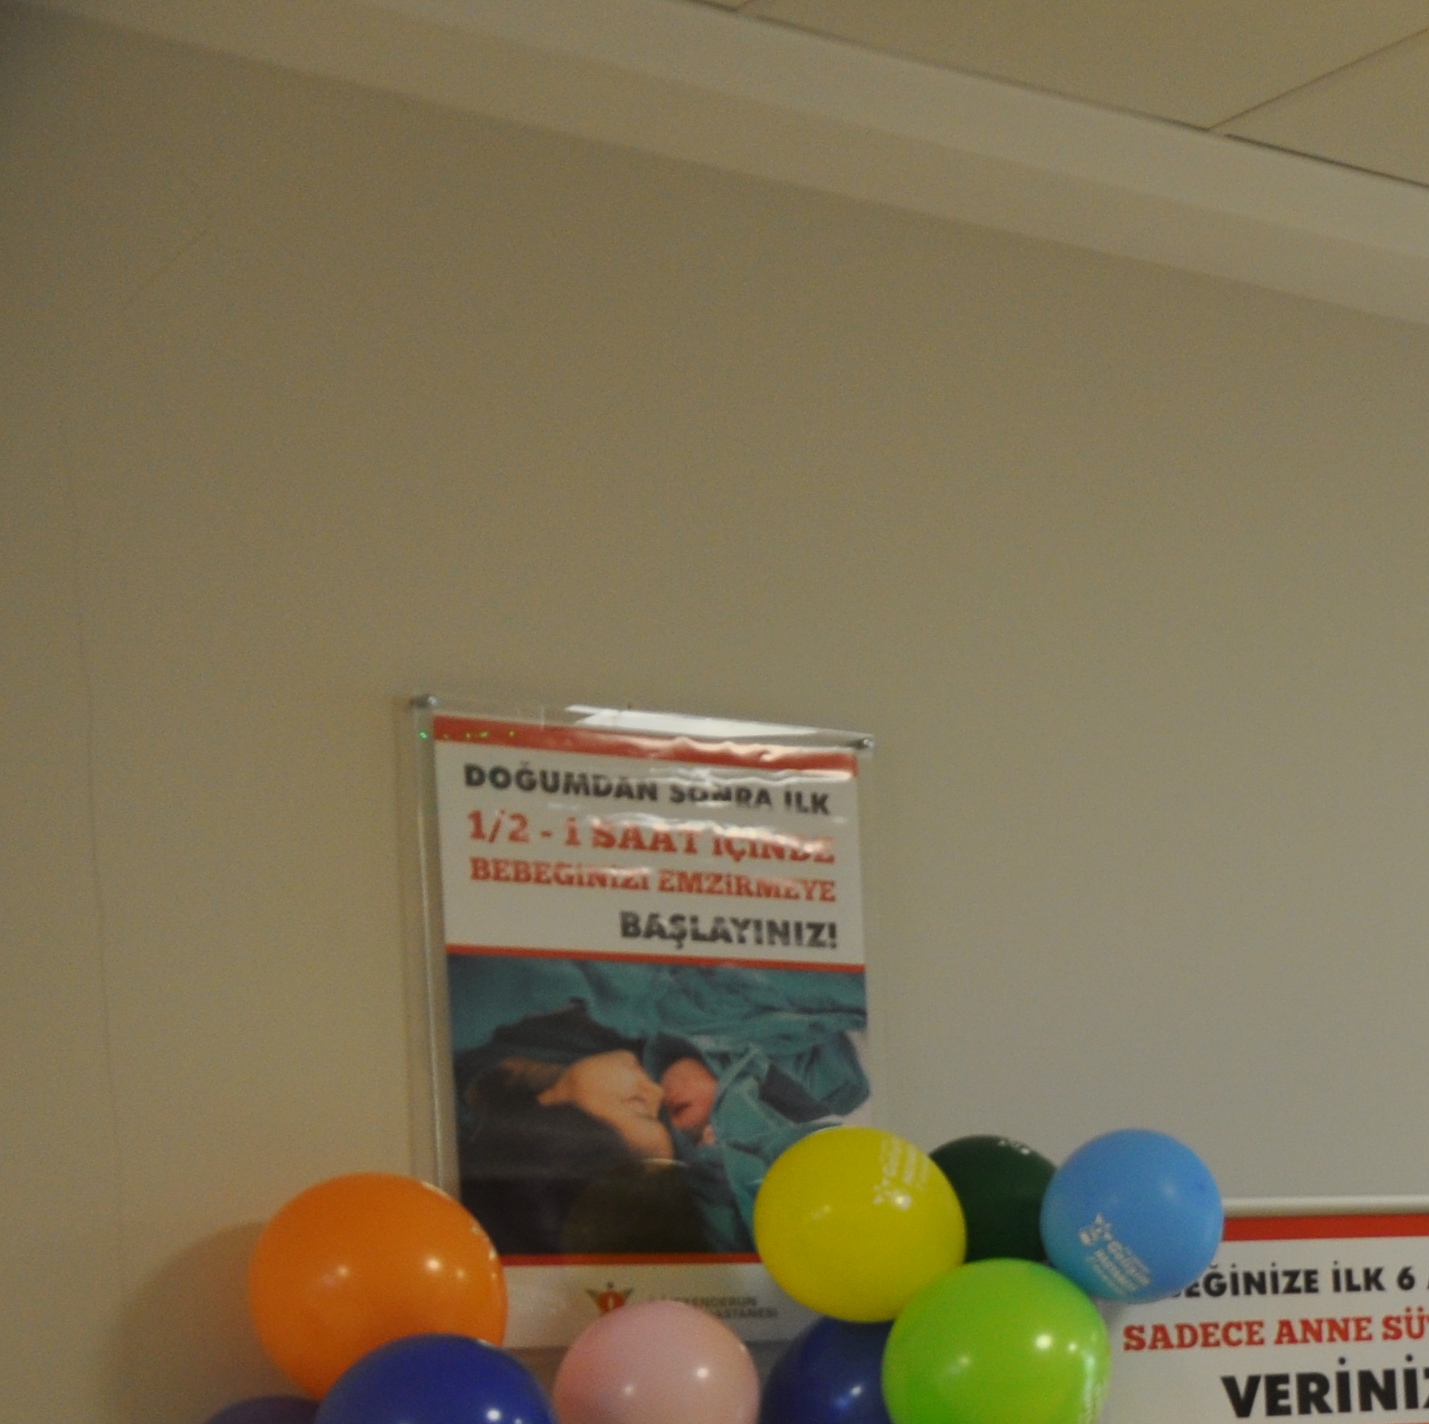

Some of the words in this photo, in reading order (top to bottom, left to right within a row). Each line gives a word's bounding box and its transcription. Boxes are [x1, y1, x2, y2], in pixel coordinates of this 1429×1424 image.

[464, 762, 658, 801] DOĞUMDAN
[468, 809, 530, 843] 1/2
[591, 816, 703, 854] SAAT
[619, 910, 839, 950] BAŞLAYINIZ!
[1331, 1259, 1386, 1293] İLK
[1396, 1266, 1416, 1291] 6
[1123, 1319, 1265, 1351] SADECE
[1274, 1315, 1373, 1345] ANNE
